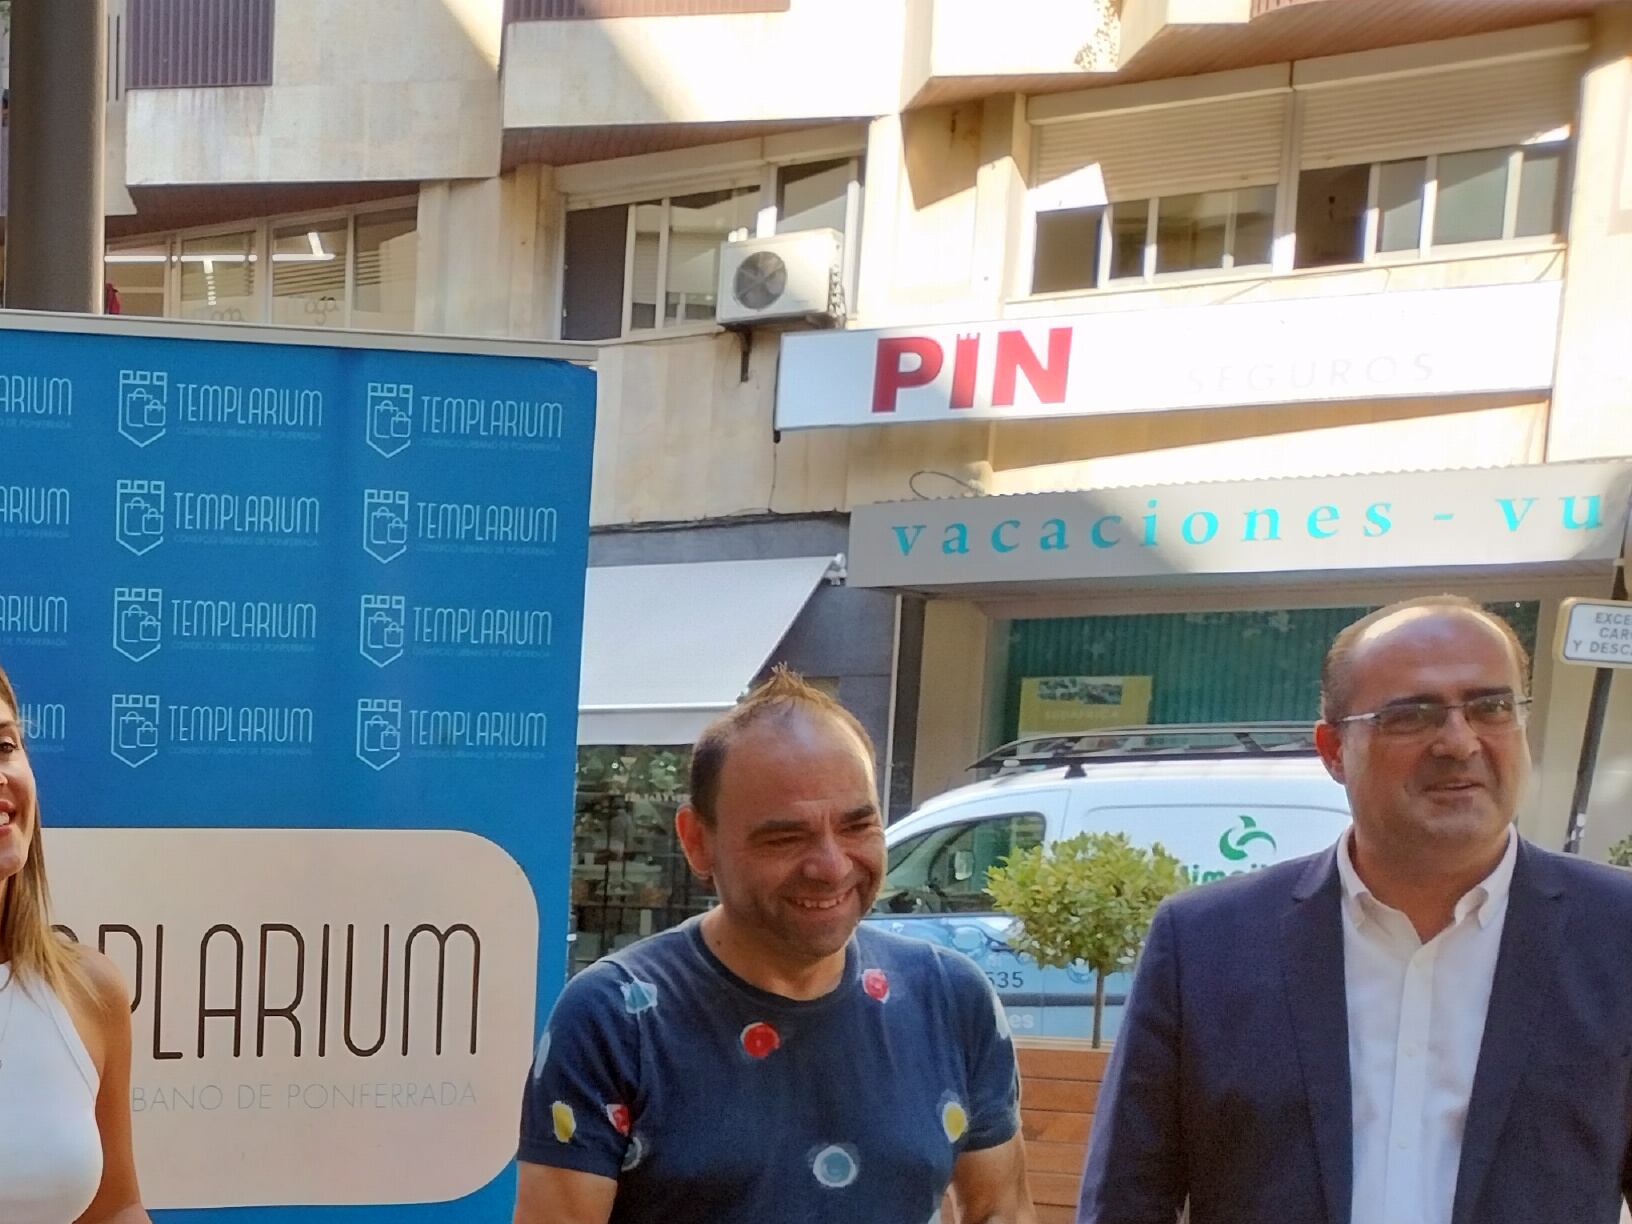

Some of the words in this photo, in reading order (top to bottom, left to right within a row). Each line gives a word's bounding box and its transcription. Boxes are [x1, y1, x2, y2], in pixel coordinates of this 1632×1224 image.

[872, 327, 1073, 413] PIN
[176, 383, 323, 426] TEMPLARIUM
[421, 395, 562, 438] TEMPLARIUM
[174, 492, 319, 533] TEMPLARIUM
[418, 501, 556, 542] TEMPLARIUM
[892, 498, 1394, 556] vacaciones
[171, 599, 316, 638] TEMPLARIUM
[414, 606, 552, 645] TEMPLARIUM
[1599, 627, 1632, 640] CAR
[1573, 640, 1582, 652] Y
[1590, 641, 1632, 656] DESC
[168, 705, 312, 742] TEMPLARIUM
[410, 709, 546, 746] TEMPLARIUM
[51, 922, 481, 1060] PLARIUM
[238, 1083, 272, 1110] DE
[287, 1081, 478, 1110] PONFERRADA
